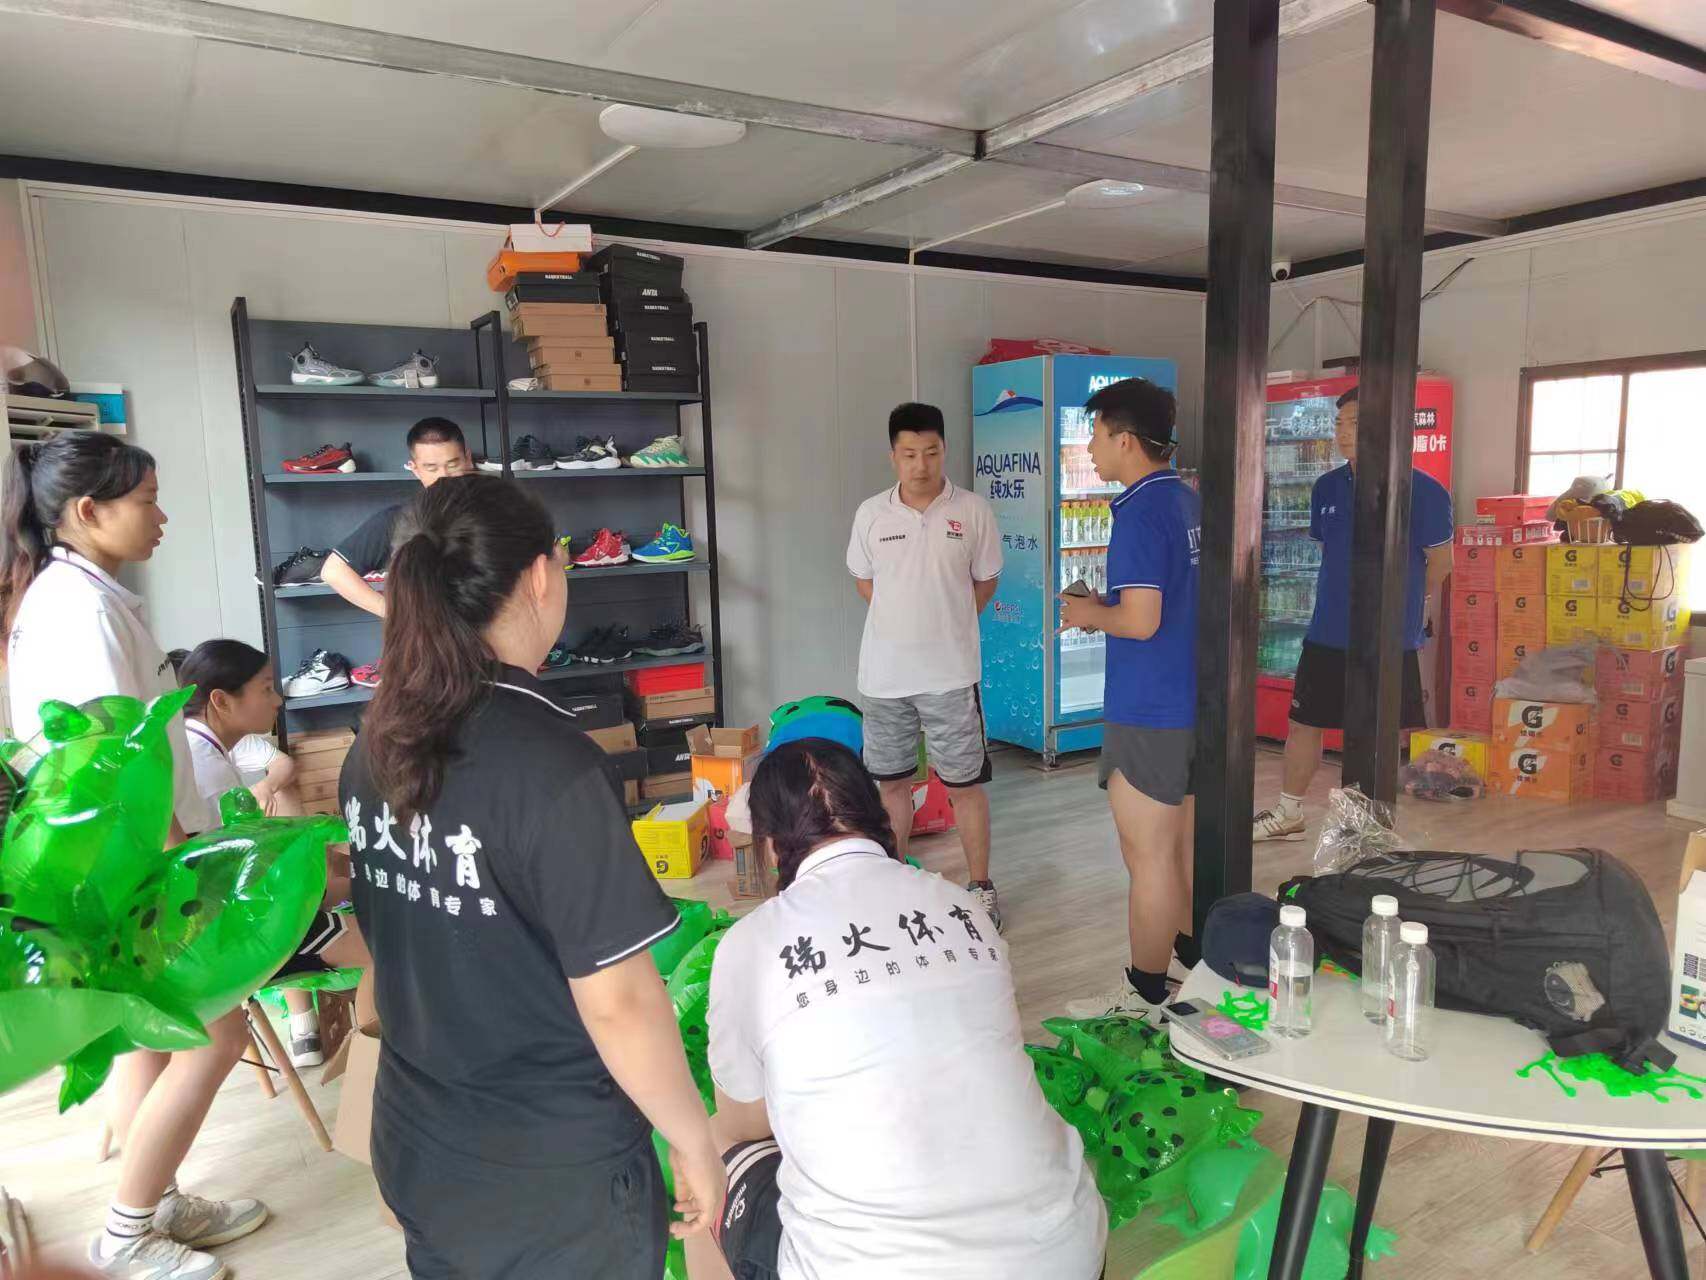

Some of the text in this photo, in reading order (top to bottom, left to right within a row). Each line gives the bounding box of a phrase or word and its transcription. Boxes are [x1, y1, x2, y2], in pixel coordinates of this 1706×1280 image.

[642, 288, 658, 297] ANTA
[975, 452, 1042, 478] AQUAFINA
[990, 479, 1025, 500] 纯水乐
[1565, 550, 1577, 562] G
[1565, 600, 1577, 612] G
[1618, 602, 1630, 614] G
[1522, 705, 1543, 728] G
[1518, 753, 1538, 774] G
